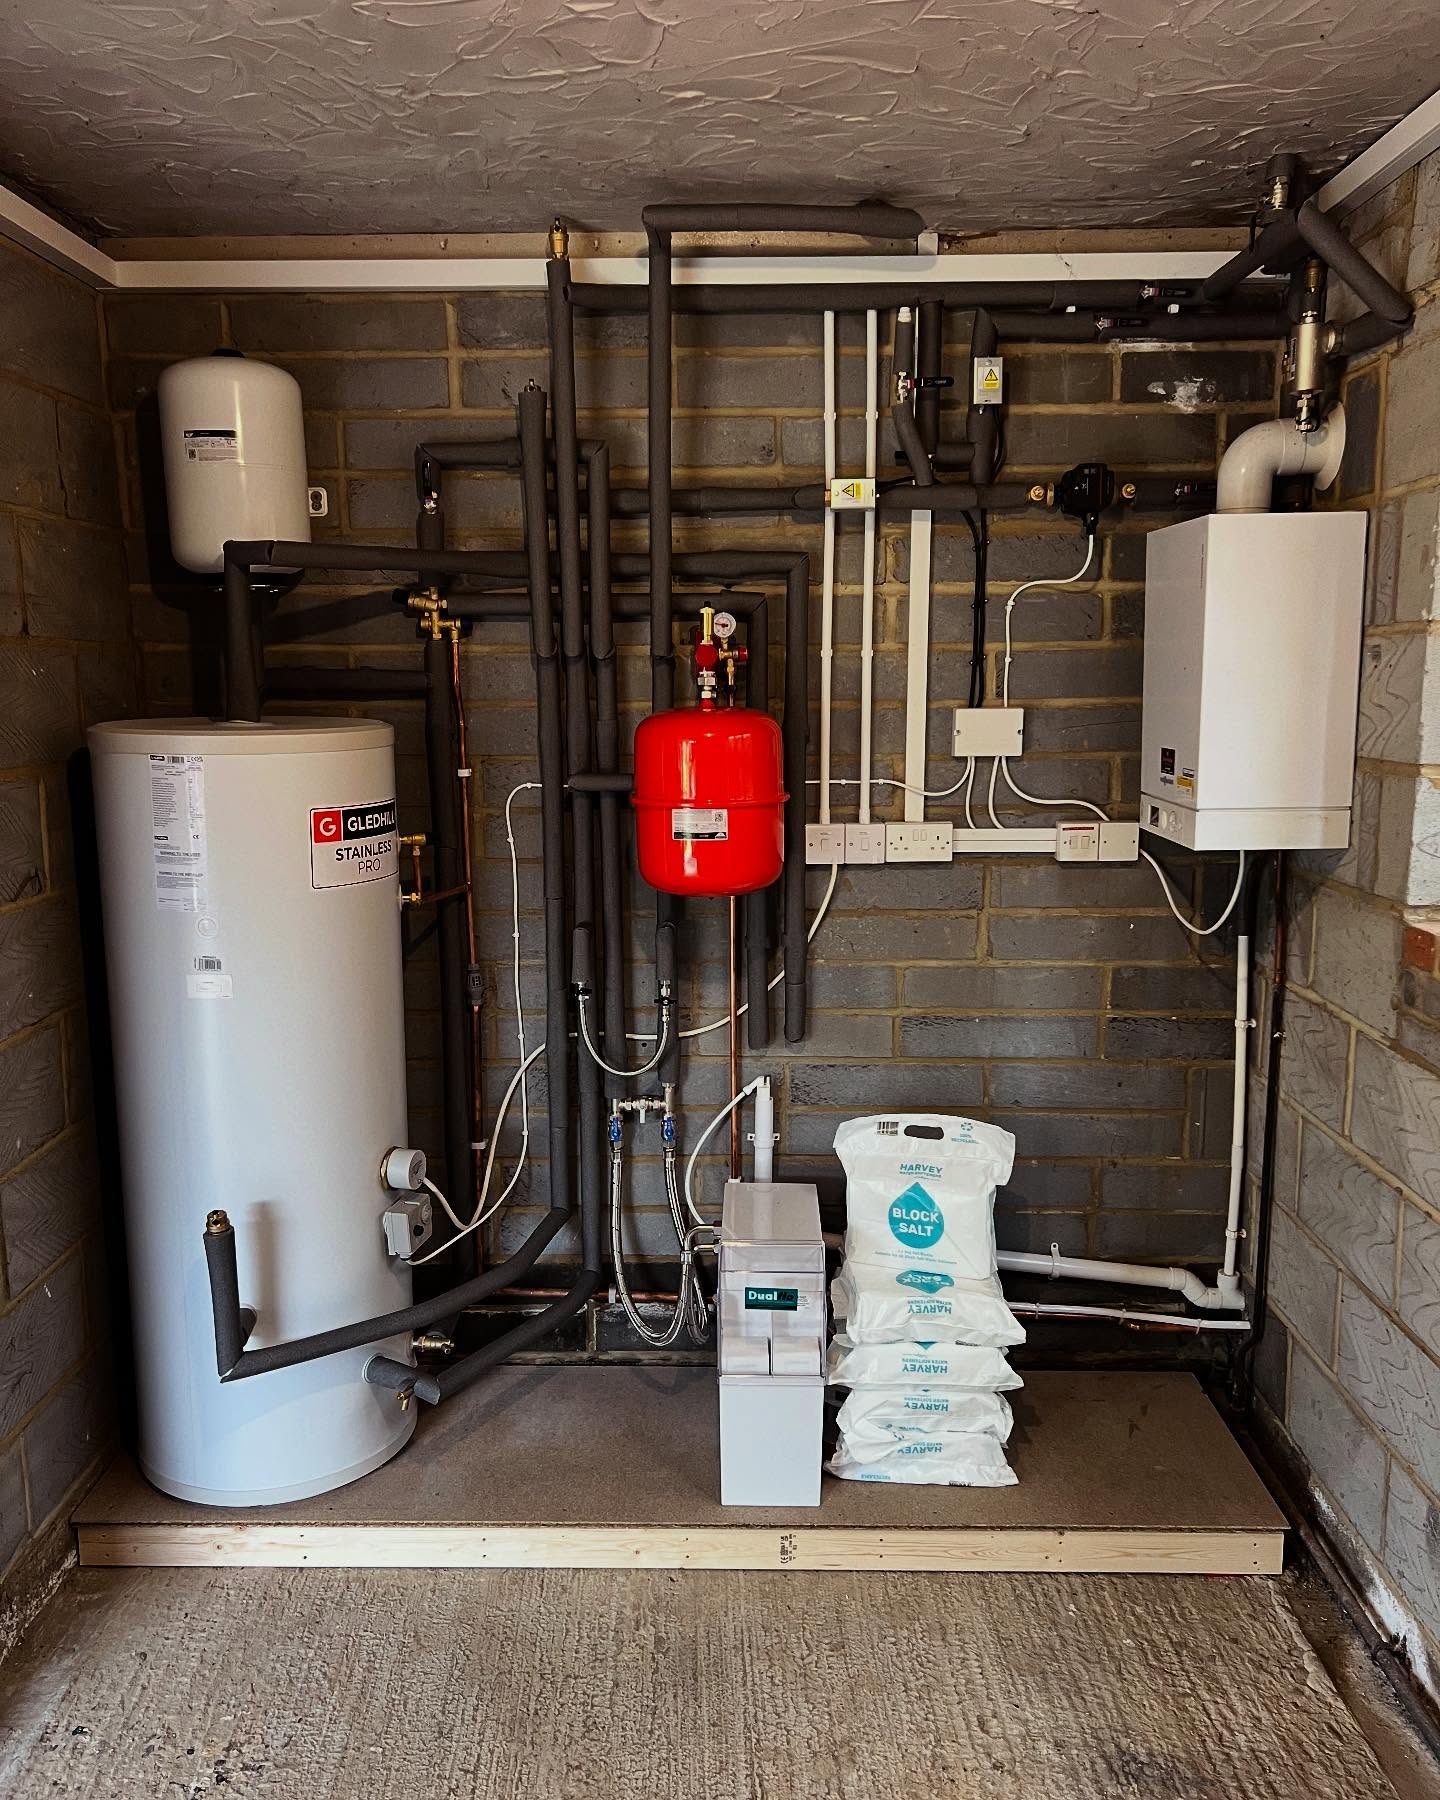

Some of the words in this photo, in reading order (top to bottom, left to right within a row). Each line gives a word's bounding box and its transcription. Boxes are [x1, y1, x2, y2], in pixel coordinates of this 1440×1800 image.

[319, 817, 337, 837] G
[347, 810, 395, 832] GLEDHILL
[335, 840, 392, 862] STAINLESS
[358, 858, 381, 875] PRO
[900, 1163, 943, 1175] HARVEY
[892, 1207, 939, 1224] BLOCK
[899, 1222, 934, 1237] SALT
[907, 1304, 952, 1315] HARVEY
[902, 1363, 948, 1374] HARVEY
[904, 1402, 949, 1412] HARVEY
[897, 1446, 942, 1454] HARVEY
